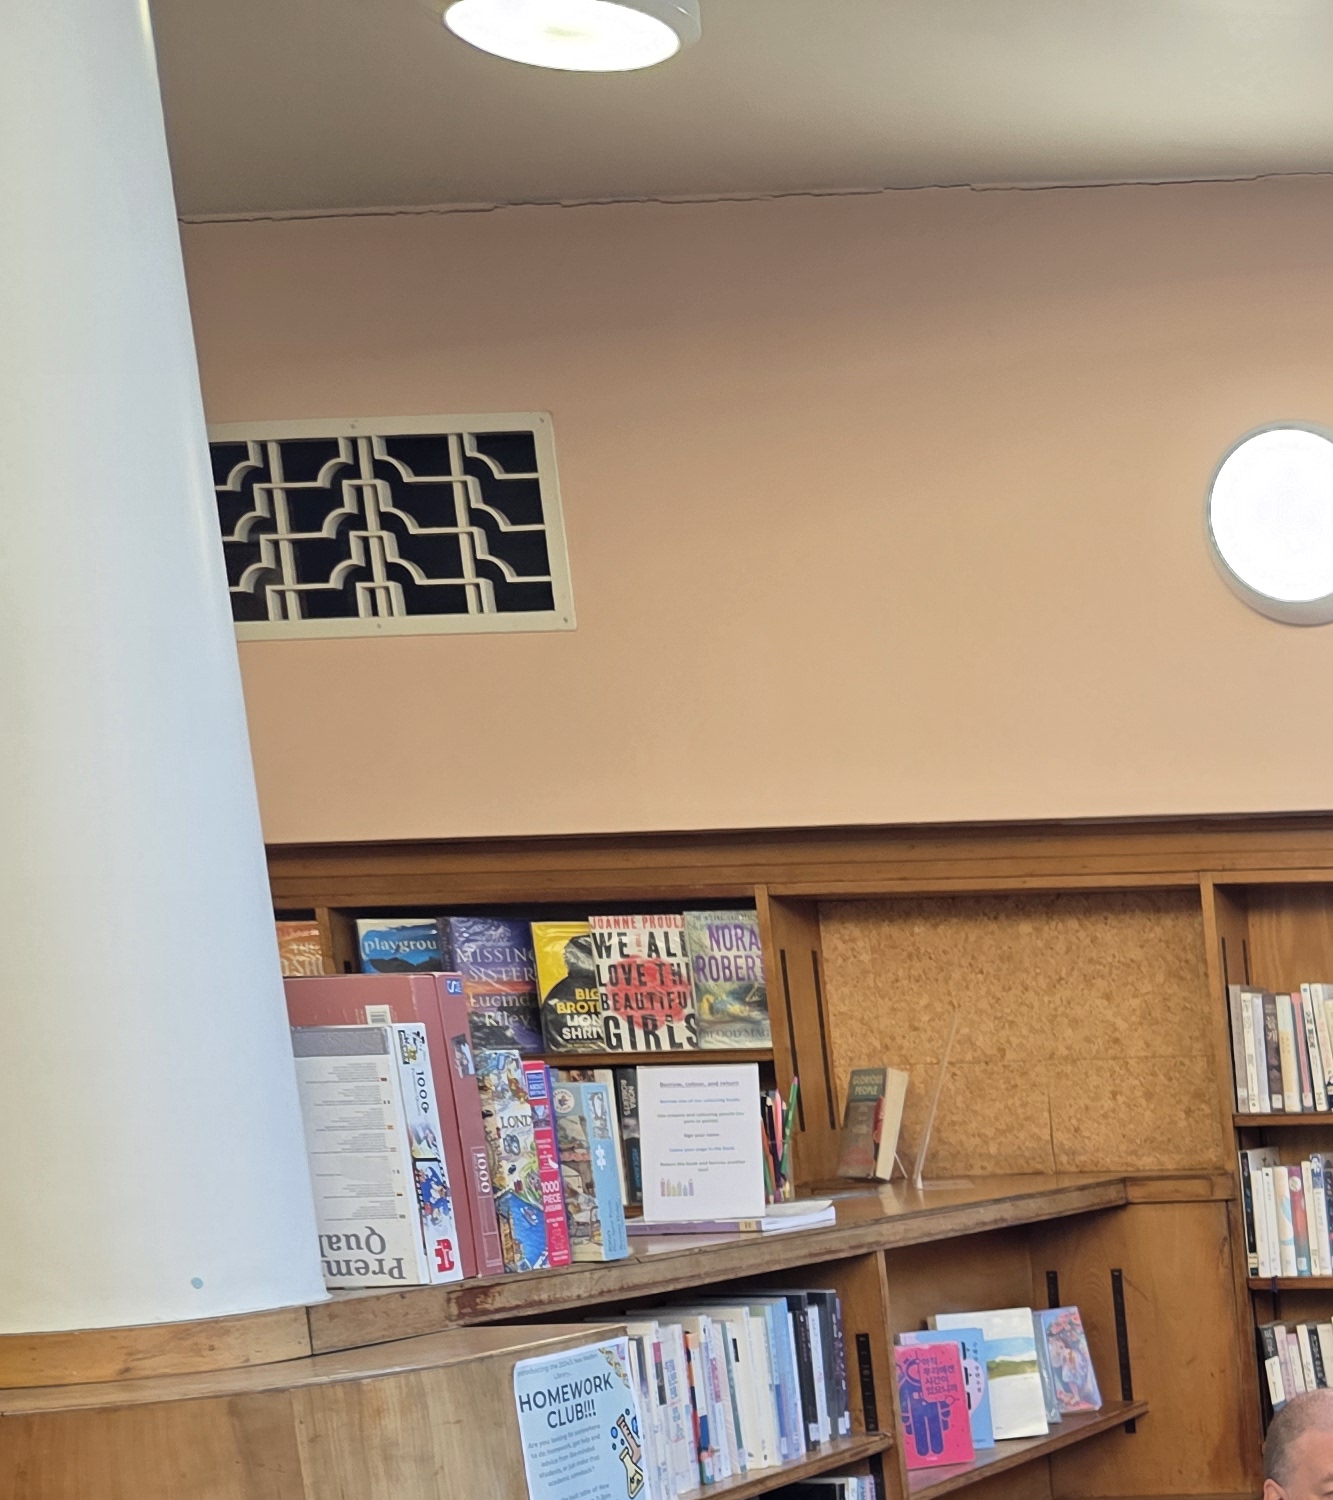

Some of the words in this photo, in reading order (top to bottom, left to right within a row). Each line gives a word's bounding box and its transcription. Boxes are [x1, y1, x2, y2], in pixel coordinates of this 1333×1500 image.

[591, 916, 637, 930] JOANNE
[363, 937, 437, 954] playgrou
[591, 932, 630, 960] WE
[707, 924, 761, 951] NORA
[468, 965, 536, 982] SISTER
[597, 964, 646, 988] LOVE
[657, 962, 692, 985] THI
[693, 955, 766, 983] ROBERT
[470, 992, 531, 1008] Lucind
[556, 1001, 600, 1014] BROT
[484, 1010, 532, 1031] Riley
[603, 1014, 698, 1051] GIRLS
[629, 1086, 637, 1110] NORA
[501, 1115, 533, 1128] LOND
[476, 1152, 490, 1193] 1000
[541, 1181, 560, 1192] 1000
[543, 1192, 562, 1204] PIECE
[322, 1227, 386, 1257] Qual
[324, 1257, 407, 1281] Prem
[519, 1372, 613, 1413] HOMEWORK
[547, 1399, 597, 1428] CLUB!!!
